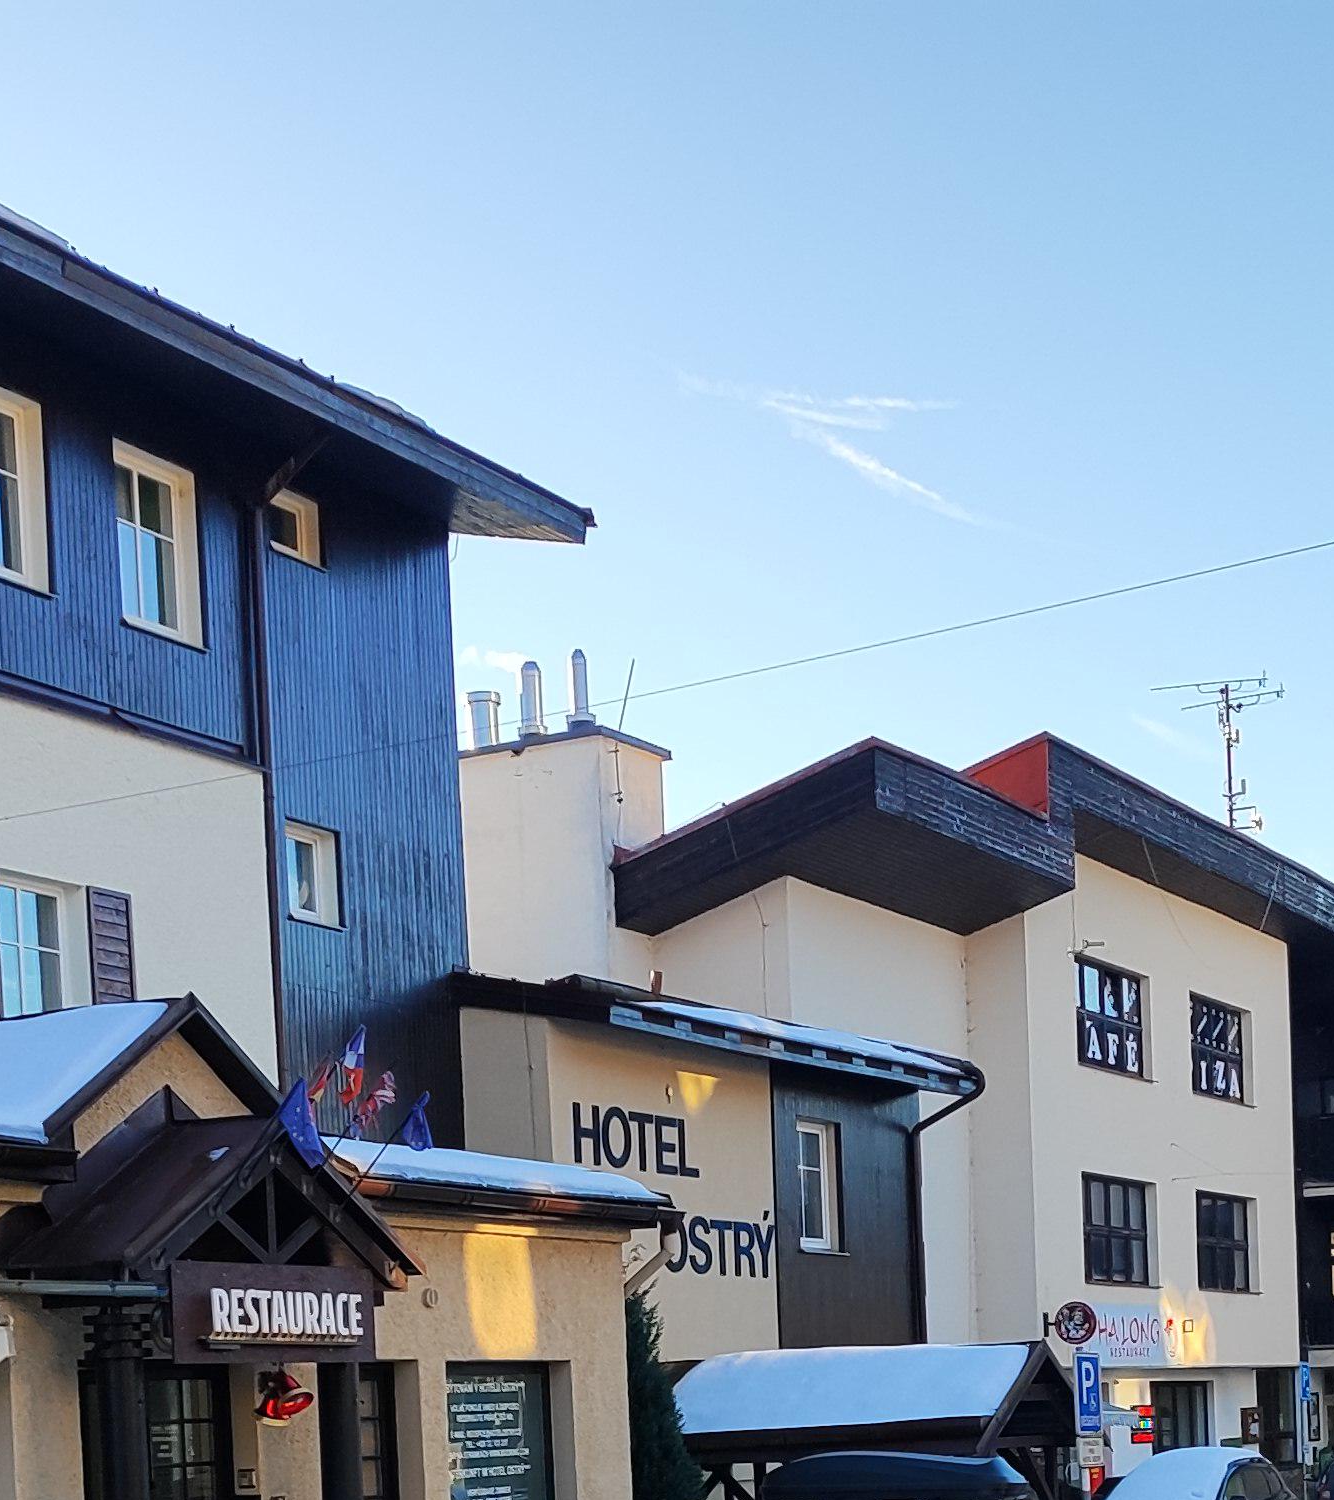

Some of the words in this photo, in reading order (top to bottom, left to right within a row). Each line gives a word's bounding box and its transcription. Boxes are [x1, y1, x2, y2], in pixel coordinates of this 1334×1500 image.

[572, 1101, 700, 1179] HOTEL
[210, 1288, 364, 1336] RESTAURACE
[1081, 1361, 1095, 1405] P
